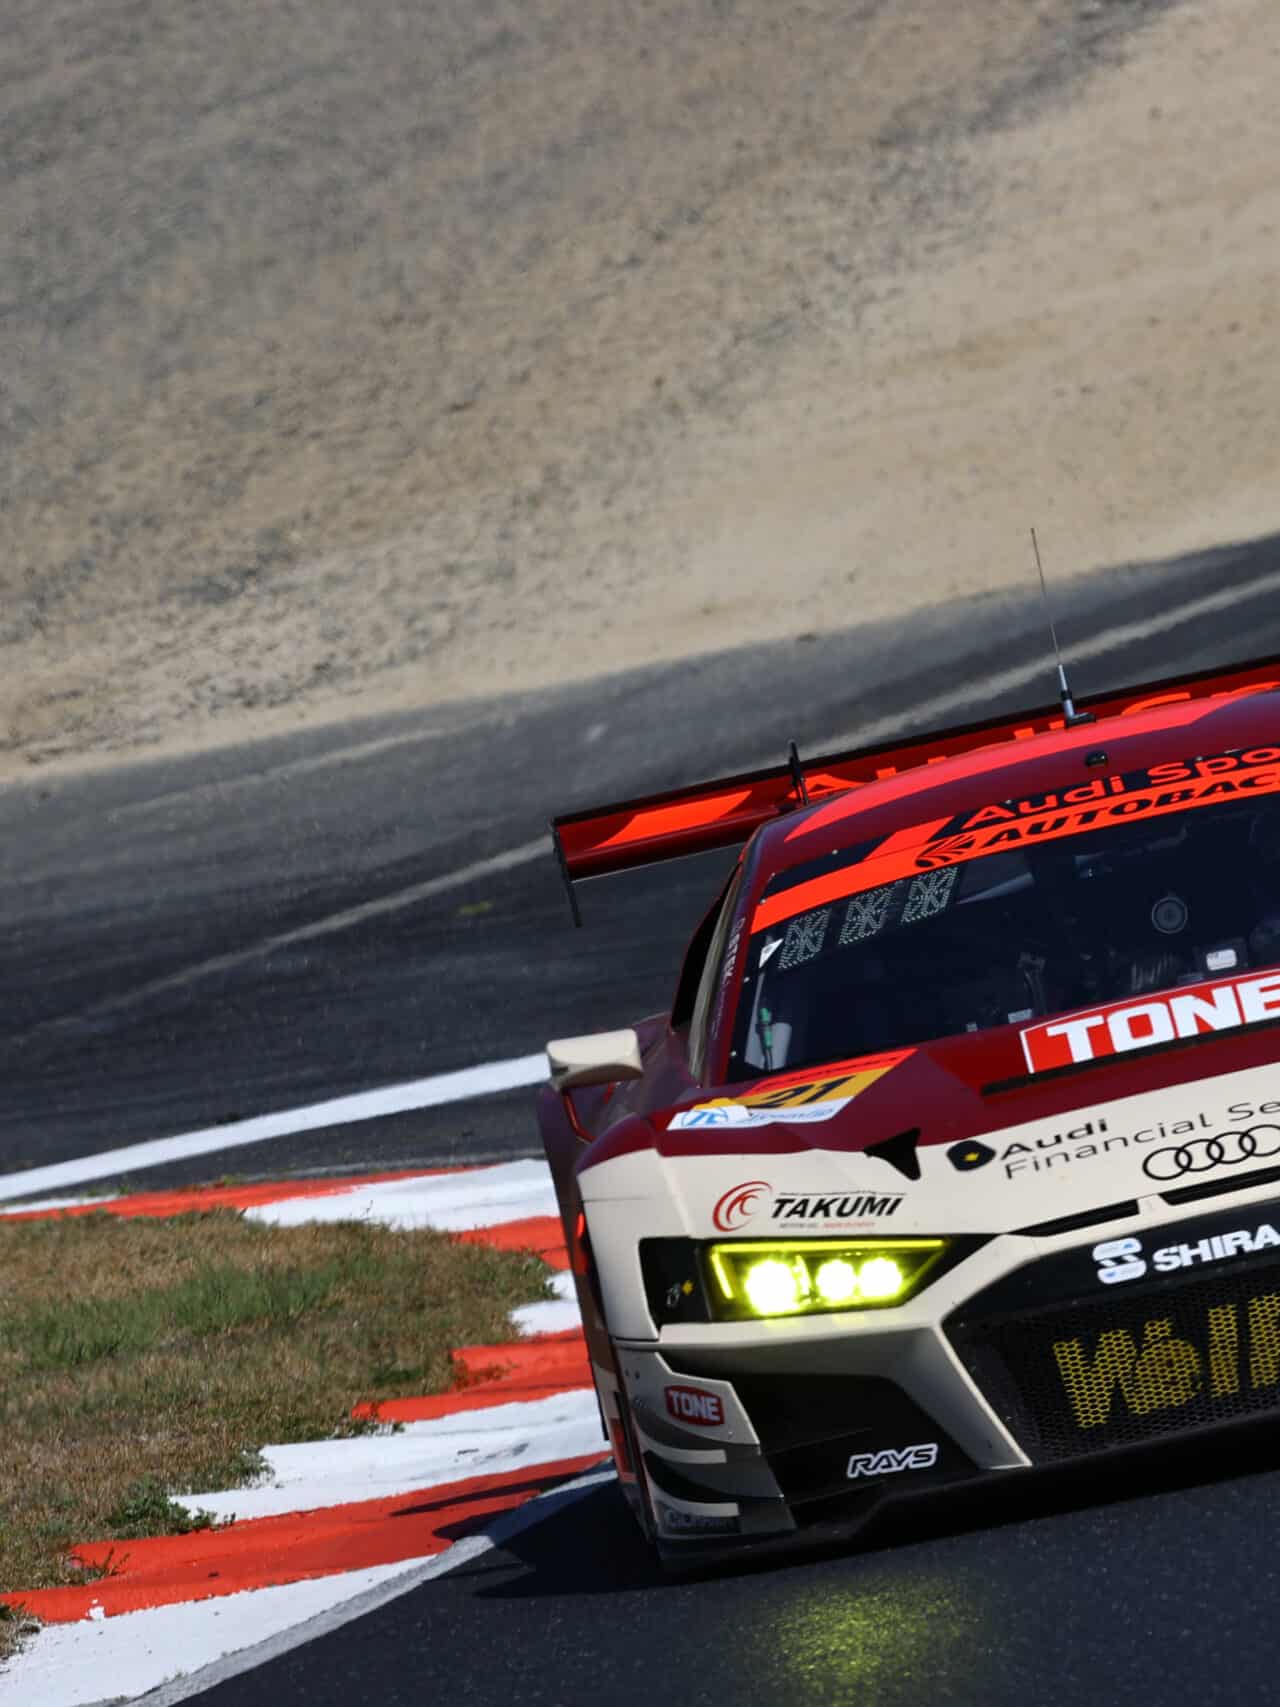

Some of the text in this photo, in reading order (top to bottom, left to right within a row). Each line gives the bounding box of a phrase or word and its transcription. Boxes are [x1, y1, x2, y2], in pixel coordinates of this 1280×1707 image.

[965, 774, 1126, 830] Audi
[999, 1118, 1109, 1160] Audi
[1004, 1113, 1208, 1181] Financial
[770, 1195, 907, 1220] TAKUMI
[667, 1390, 723, 1422] TONE
[846, 1442, 939, 1479] RAYS
